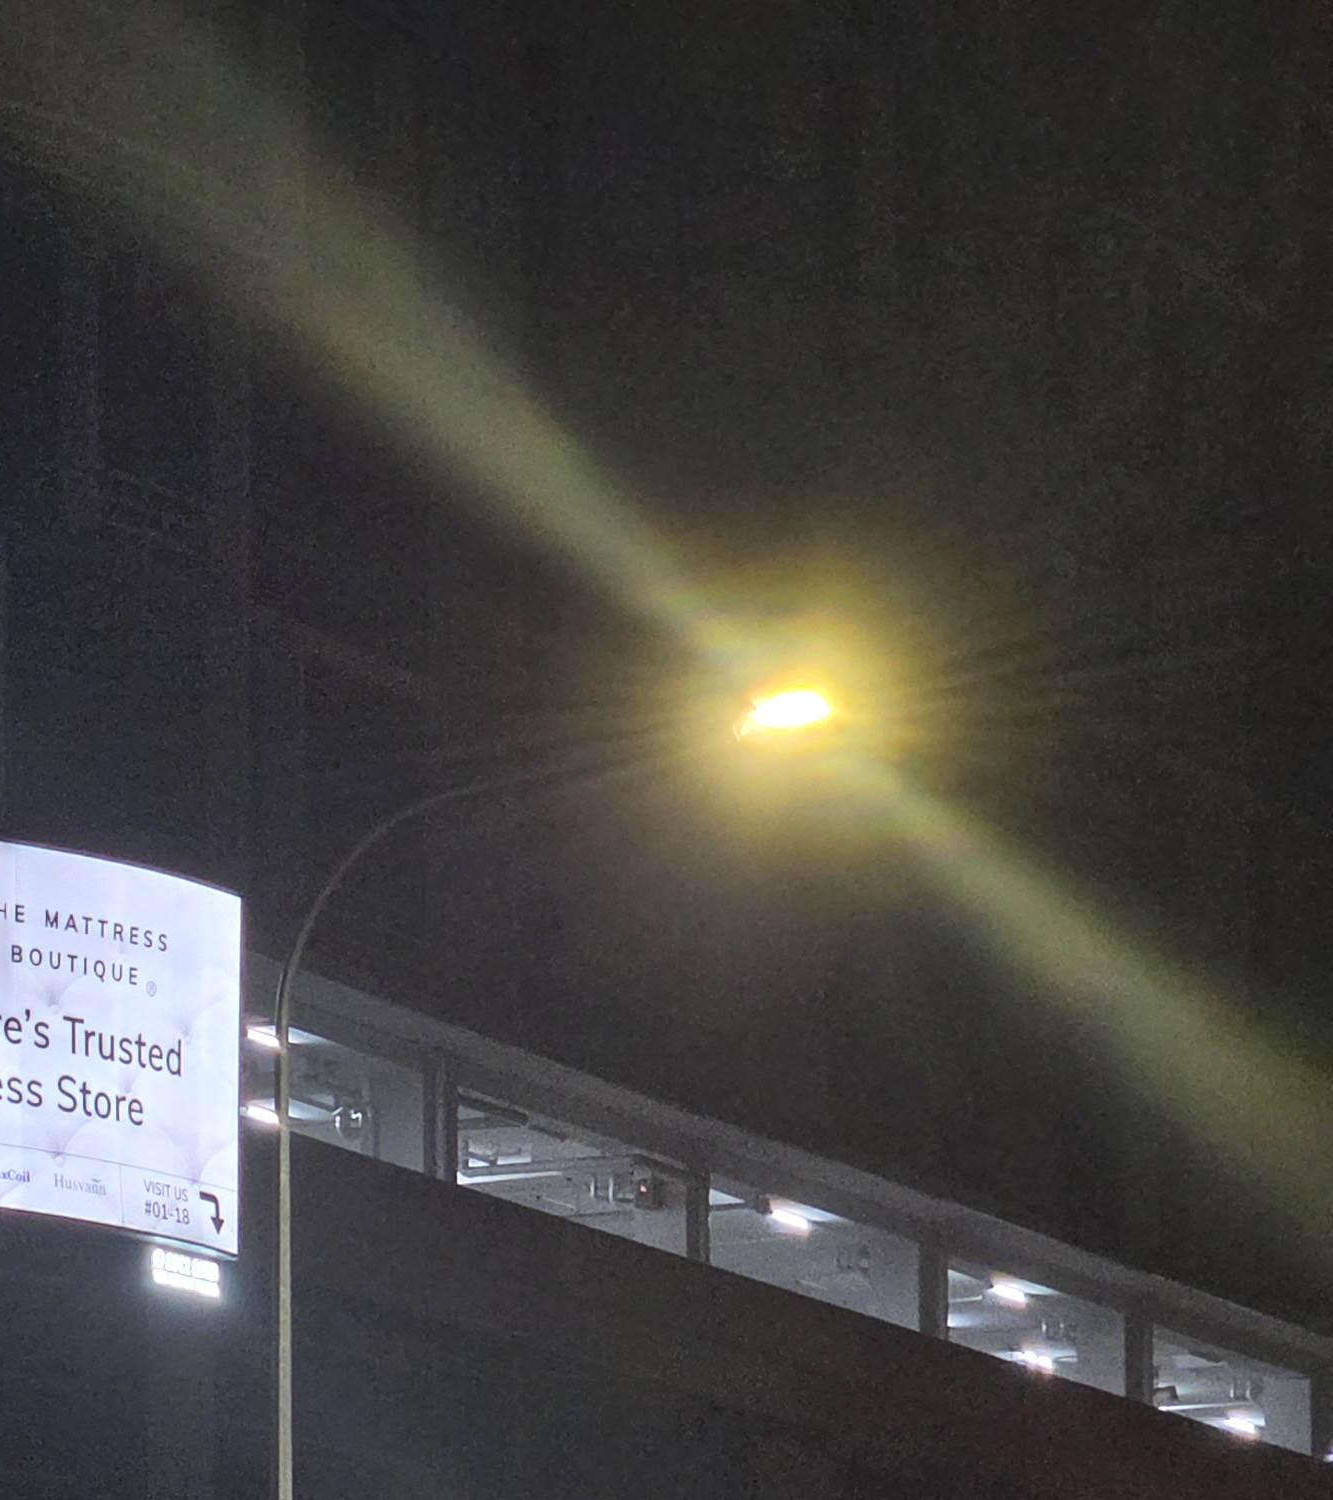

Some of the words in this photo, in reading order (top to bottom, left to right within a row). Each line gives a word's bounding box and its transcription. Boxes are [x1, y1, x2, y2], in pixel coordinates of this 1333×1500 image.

[44, 909, 169, 952] MATTRESS
[11, 944, 138, 986] BOUTIQUE
[62, 1015, 182, 1078] Trusted
[57, 1075, 145, 1126] Store
[143, 1179, 170, 1198] VISIT
[174, 1186, 189, 1202] US
[144, 1200, 190, 1225] #01-18
